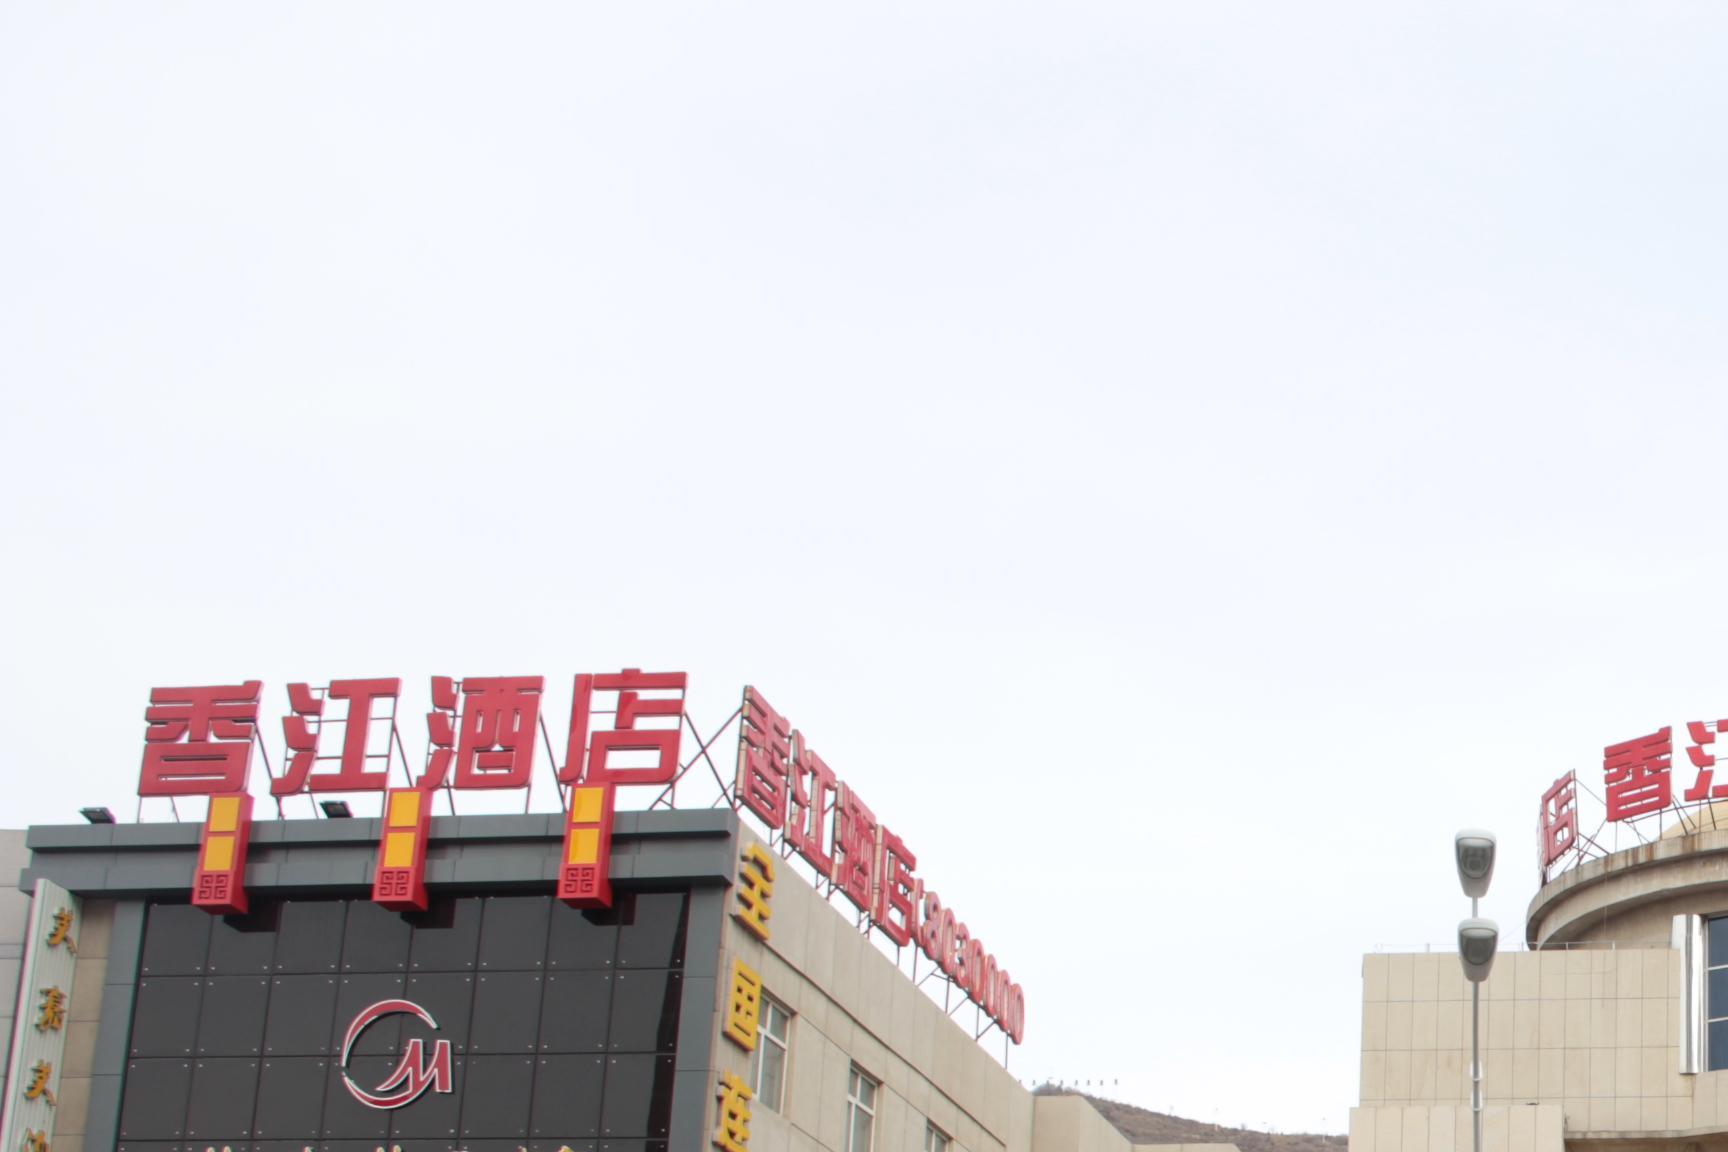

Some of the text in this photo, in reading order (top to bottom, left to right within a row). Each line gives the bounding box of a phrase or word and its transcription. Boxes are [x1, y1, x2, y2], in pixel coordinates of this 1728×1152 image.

[138, 668, 688, 797] 香江酒店
[734, 684, 917, 948] 香江酒店
